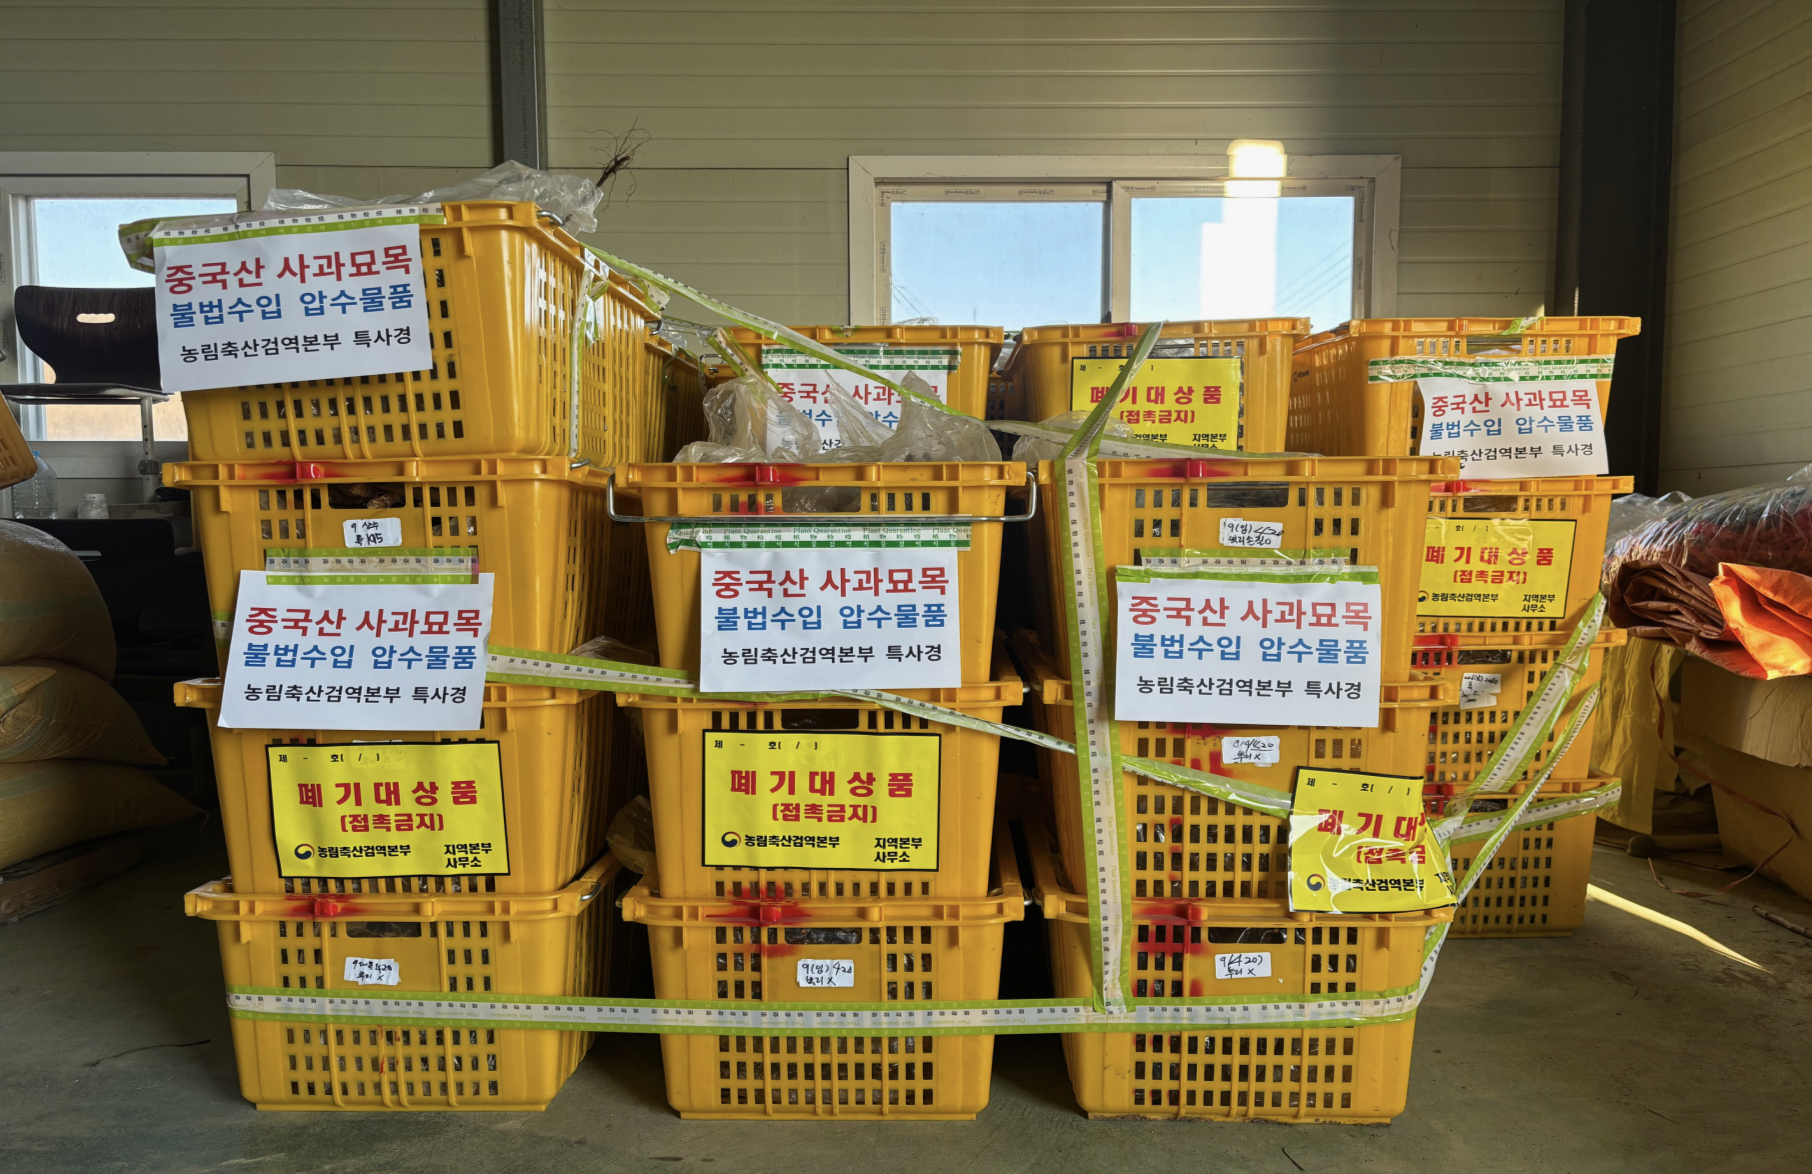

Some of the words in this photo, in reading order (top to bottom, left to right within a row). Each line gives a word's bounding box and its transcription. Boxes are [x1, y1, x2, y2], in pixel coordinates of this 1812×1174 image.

[165, 257, 265, 295] 중국산
[276, 244, 412, 284] 사과묘목
[170, 293, 282, 328] 불법수입
[300, 283, 414, 317] 압수물품
[180, 333, 342, 363] 농림축산검역본부
[353, 326, 412, 348] 특사경
[1431, 392, 1492, 417] 중국산
[1500, 389, 1592, 411] 사과묘목
[1120, 410, 1195, 424] (접촉금지)
[1429, 417, 1502, 440] 불법수입
[1515, 415, 1594, 435] 압수물품
[1551, 443, 1594, 456] 특사경
[723, 527, 747, 535] Plant
[750, 527, 782, 535] Quarantine
[819, 527, 852, 535] Quarantine
[862, 526, 886, 534] Plant
[1425, 546, 1554, 566] 폐기대상품
[712, 568, 809, 599] 중국산
[819, 567, 949, 597] 사과묘목
[1453, 570, 1527, 584] (접촉금지)
[1431, 592, 1498, 602] 농림축산검역본부
[1522, 594, 1556, 603] 지역본부
[714, 605, 822, 631] 불법수입
[839, 603, 947, 629] 압수물품
[1128, 596, 1229, 627] 중국산
[1240, 598, 1373, 632] 사과묘목
[1521, 604, 1546, 613] 사무소
[245, 607, 346, 637] 중국산
[355, 608, 483, 638] 사과묘목
[243, 642, 355, 668] 불법수입
[371, 645, 477, 670] 압수물품
[721, 646, 875, 665] 농림축산검역본부
[885, 644, 942, 662] 특사경
[1130, 633, 1242, 661] 불법수입
[1259, 637, 1369, 665] 압수물품
[244, 684, 401, 704] 농림축산검역본부
[411, 686, 467, 704] 특사경
[1136, 676, 1294, 698] 농림축산검역본부
[1304, 681, 1362, 700] 특사경
[714, 740, 723, 749] 제
[278, 754, 288, 763] 제
[730, 770, 914, 798] 폐기대상품
[1306, 778, 1315, 788] 제
[297, 780, 478, 808] 폐기대상품
[340, 813, 444, 832] (접촉금지)
[772, 803, 877, 823] (접촉금지)
[317, 845, 411, 858] 농림축산검역본부
[444, 842, 492, 856] 지역본부
[744, 835, 840, 848] 농림축산검역본부
[874, 837, 922, 850] 지역본부
[445, 857, 482, 869] 사무소
[874, 851, 910, 863] 사무소
